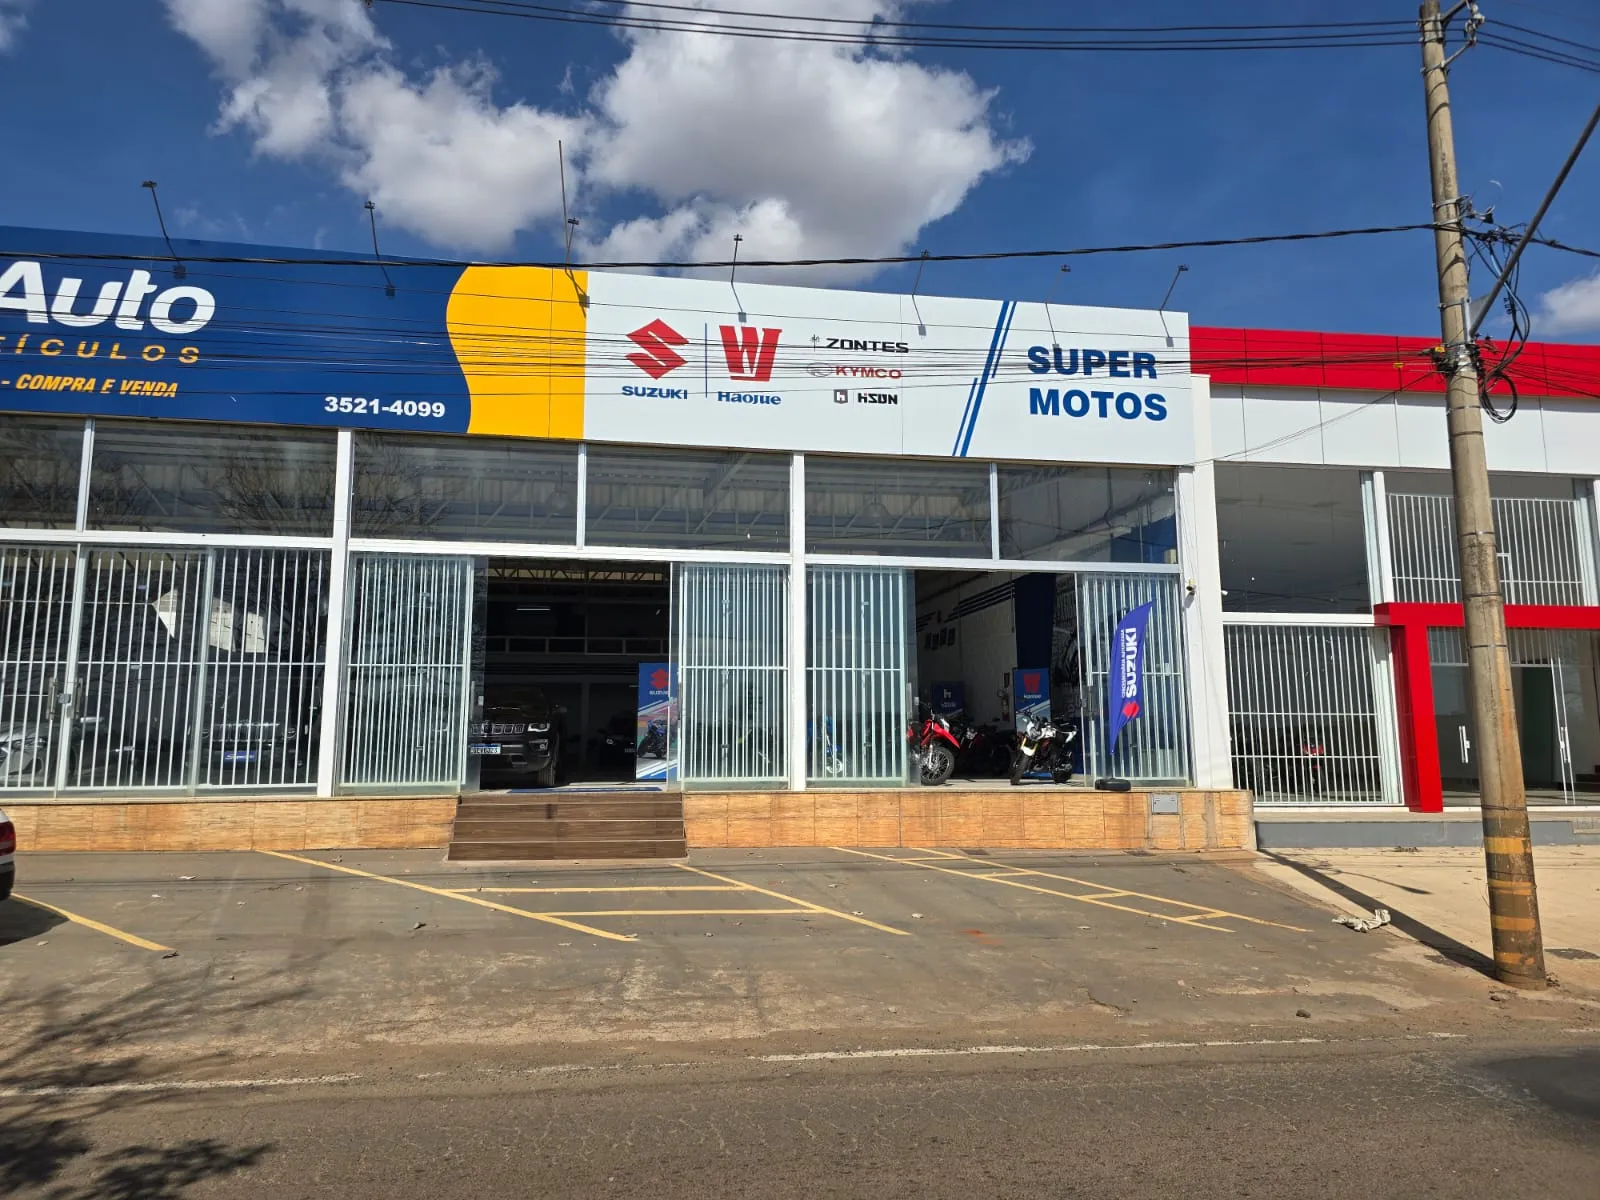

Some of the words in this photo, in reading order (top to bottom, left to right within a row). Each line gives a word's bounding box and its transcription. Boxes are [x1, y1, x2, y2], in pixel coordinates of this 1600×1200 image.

[0, 261, 215, 334] Auto
[826, 338, 909, 353] ZONTES
[835, 366, 902, 379] KYMCO
[1027, 346, 1157, 379] SUPER
[16, 374, 96, 392] COMPRA
[100, 379, 115, 394] E
[119, 380, 178, 397] VENDA
[622, 385, 688, 400] SUZUKI
[324, 396, 445, 417] 3521-4099
[717, 391, 782, 405] Haojue
[1029, 388, 1168, 421] MOTOS
[1125, 627, 1137, 698] SUZUKI
